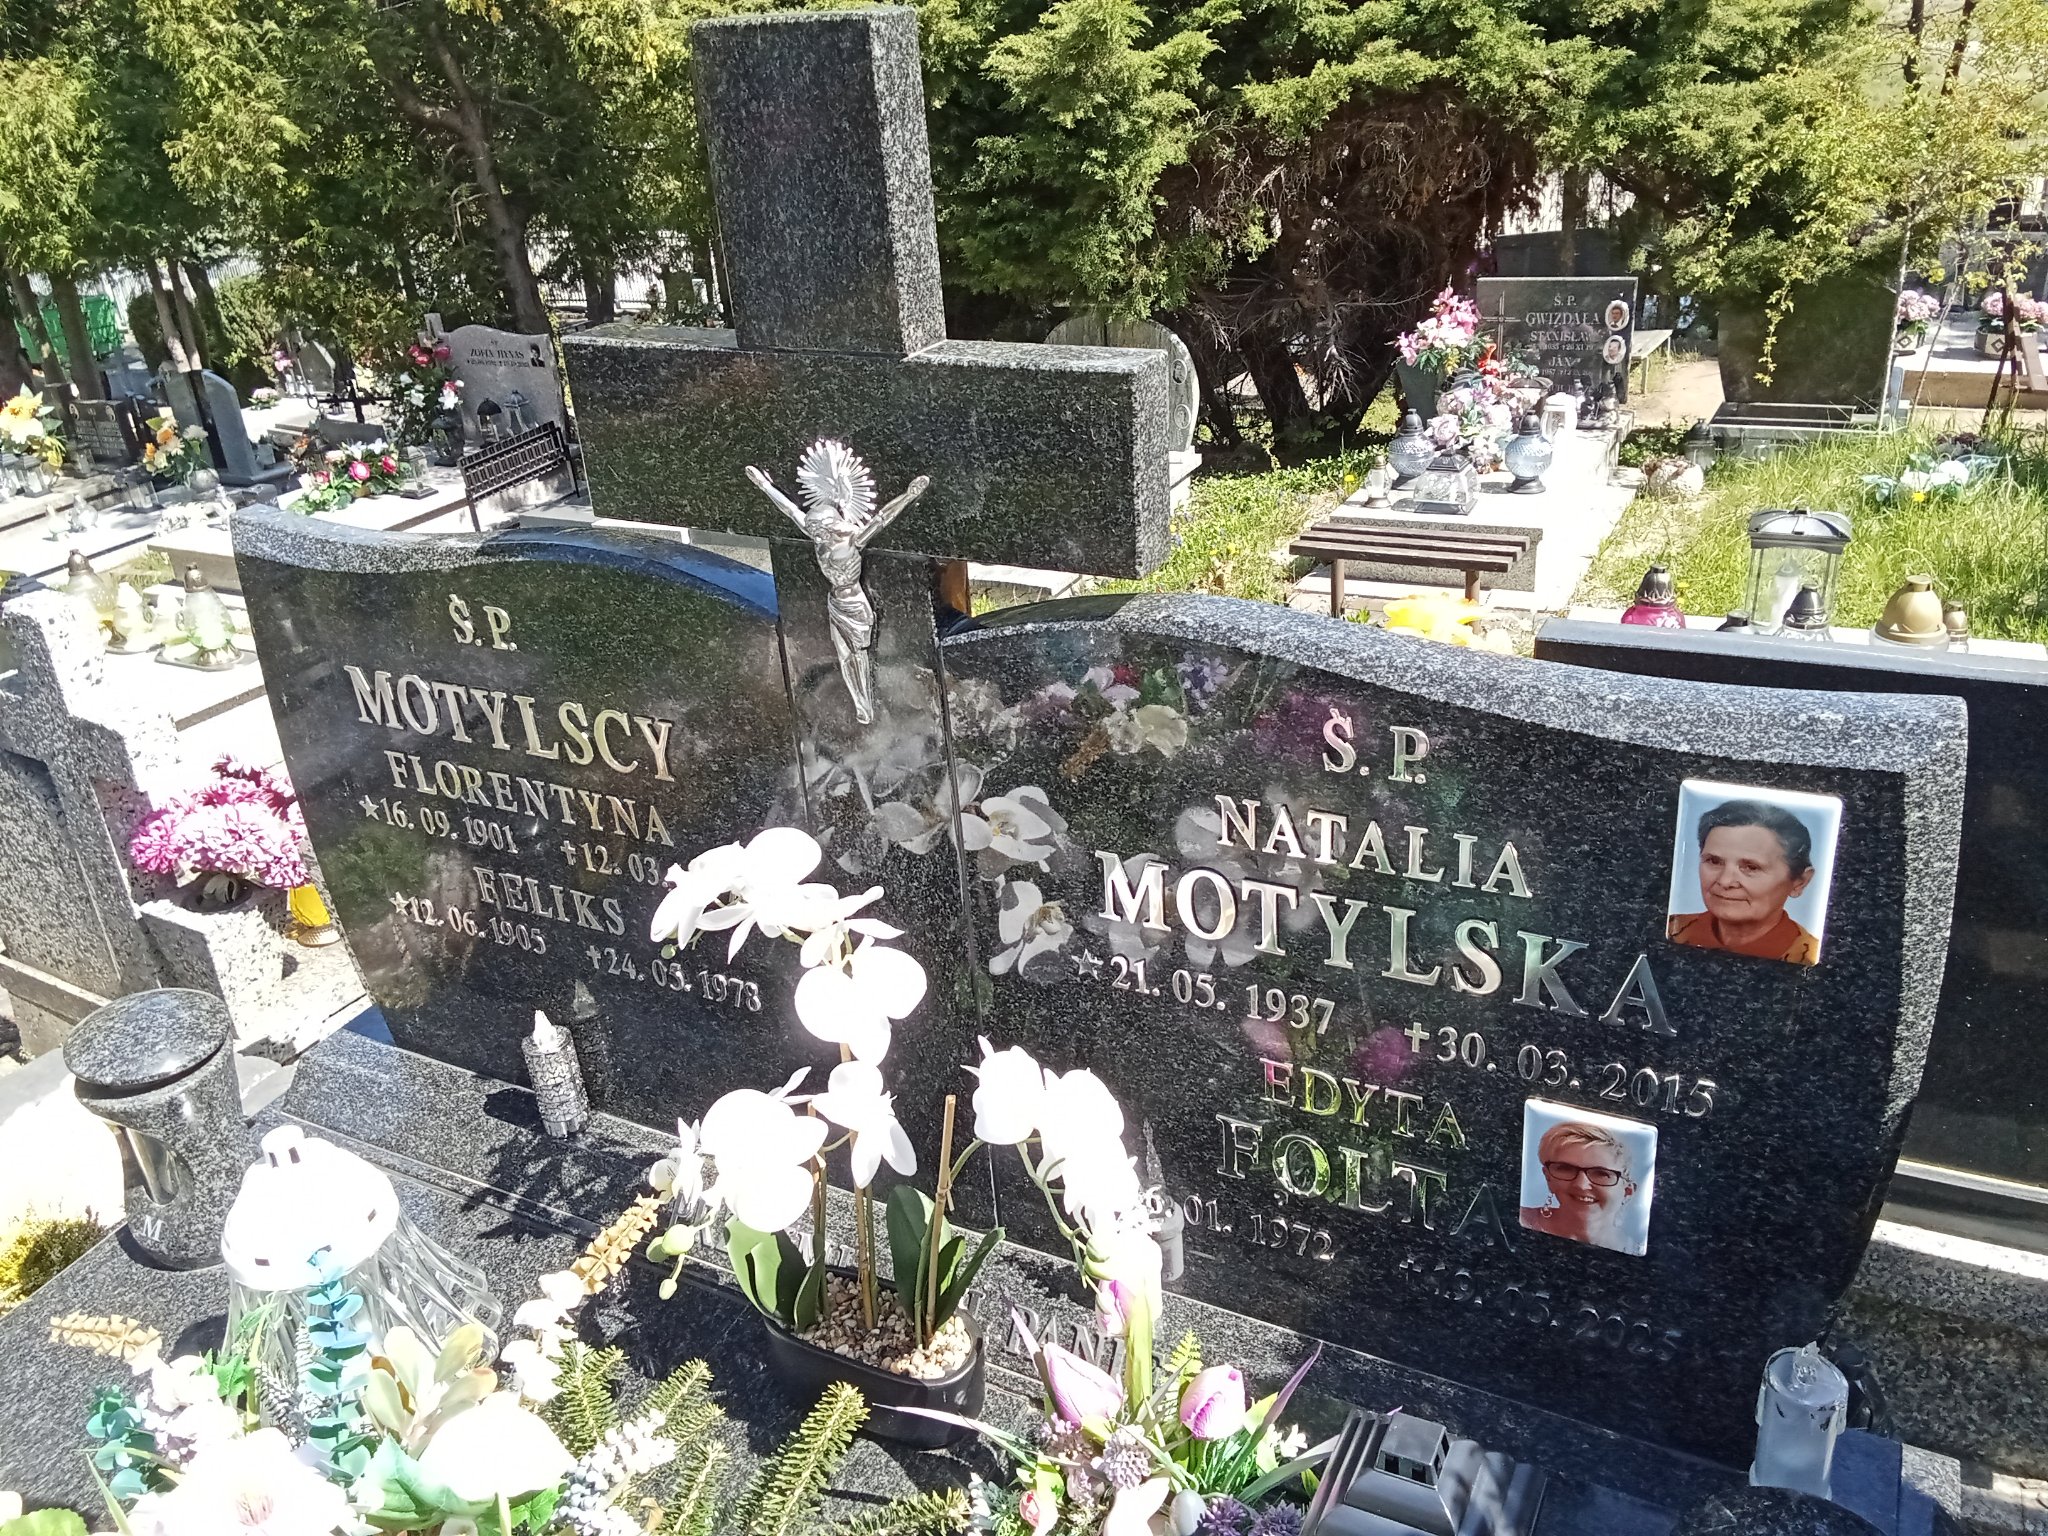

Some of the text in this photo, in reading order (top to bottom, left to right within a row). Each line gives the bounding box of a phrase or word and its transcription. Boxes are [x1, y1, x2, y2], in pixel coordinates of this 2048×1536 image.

[344, 664, 675, 782] MOTYLSCY
[381, 800, 415, 831] 16.
[420, 808, 459, 840] 09.
[462, 815, 519, 854] 1901
[383, 749, 675, 847] FLORENTYNA
[1215, 794, 1533, 899] NATALIA
[473, 866, 626, 937] FELIKS
[1095, 849, 1678, 1038] MOTYLSKA
[490, 916, 547, 955] 1905
[604, 947, 645, 982] 24.
[697, 970, 762, 1012] 1978
[1245, 983, 1336, 1035] 1937
[1599, 1061, 1718, 1118] 2015
[1259, 1057, 1469, 1150] EDYTA
[139, 1214, 163, 1242] M
[1215, 1114, 1517, 1254] FOLTA
[1250, 1212, 1337, 1262] 1972
